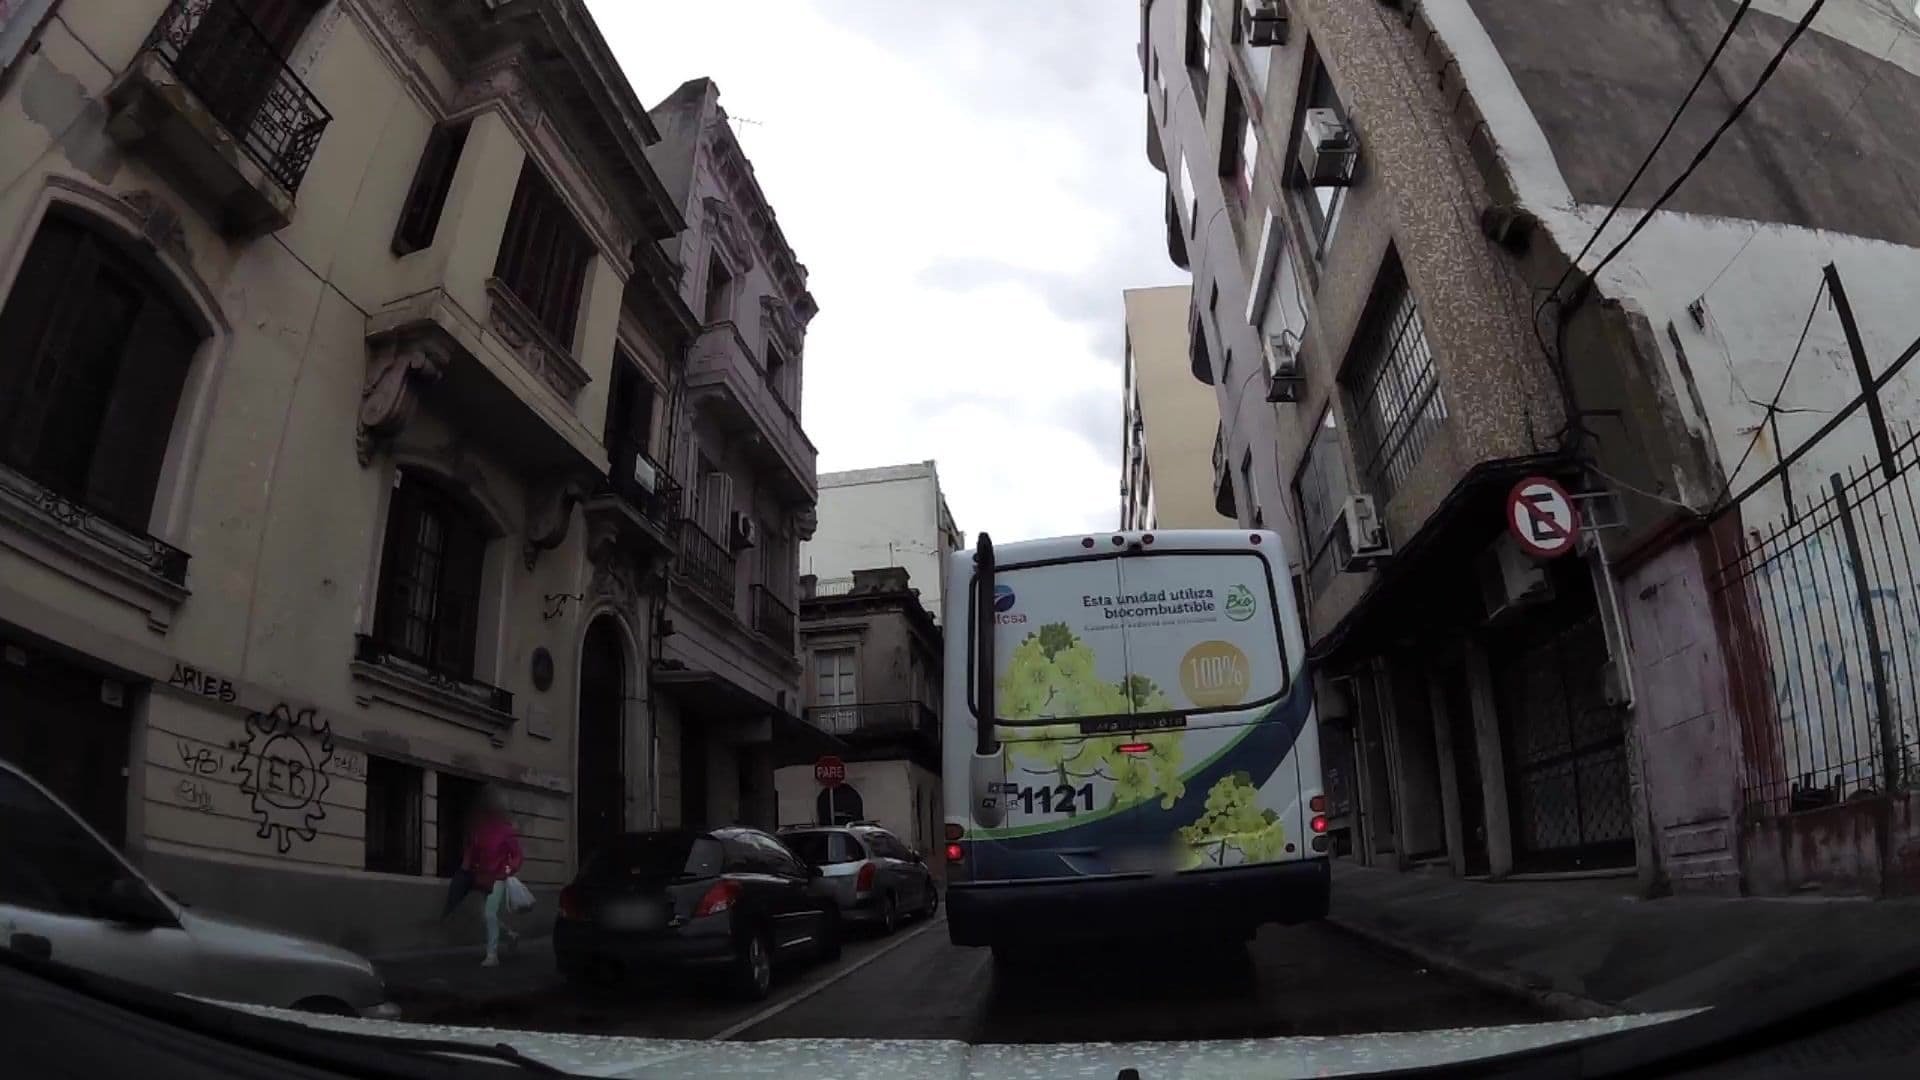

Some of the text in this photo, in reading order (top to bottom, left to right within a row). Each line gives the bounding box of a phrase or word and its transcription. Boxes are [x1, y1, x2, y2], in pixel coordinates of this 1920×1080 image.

[1082, 588, 1214, 608] Esta unidad utiliza
[1225, 594, 1254, 609] Bio
[1103, 600, 1216, 619] biocombustible
[1189, 654, 1243, 689] 100%
[817, 766, 843, 779] PARE
[1018, 783, 1094, 815] 1121
